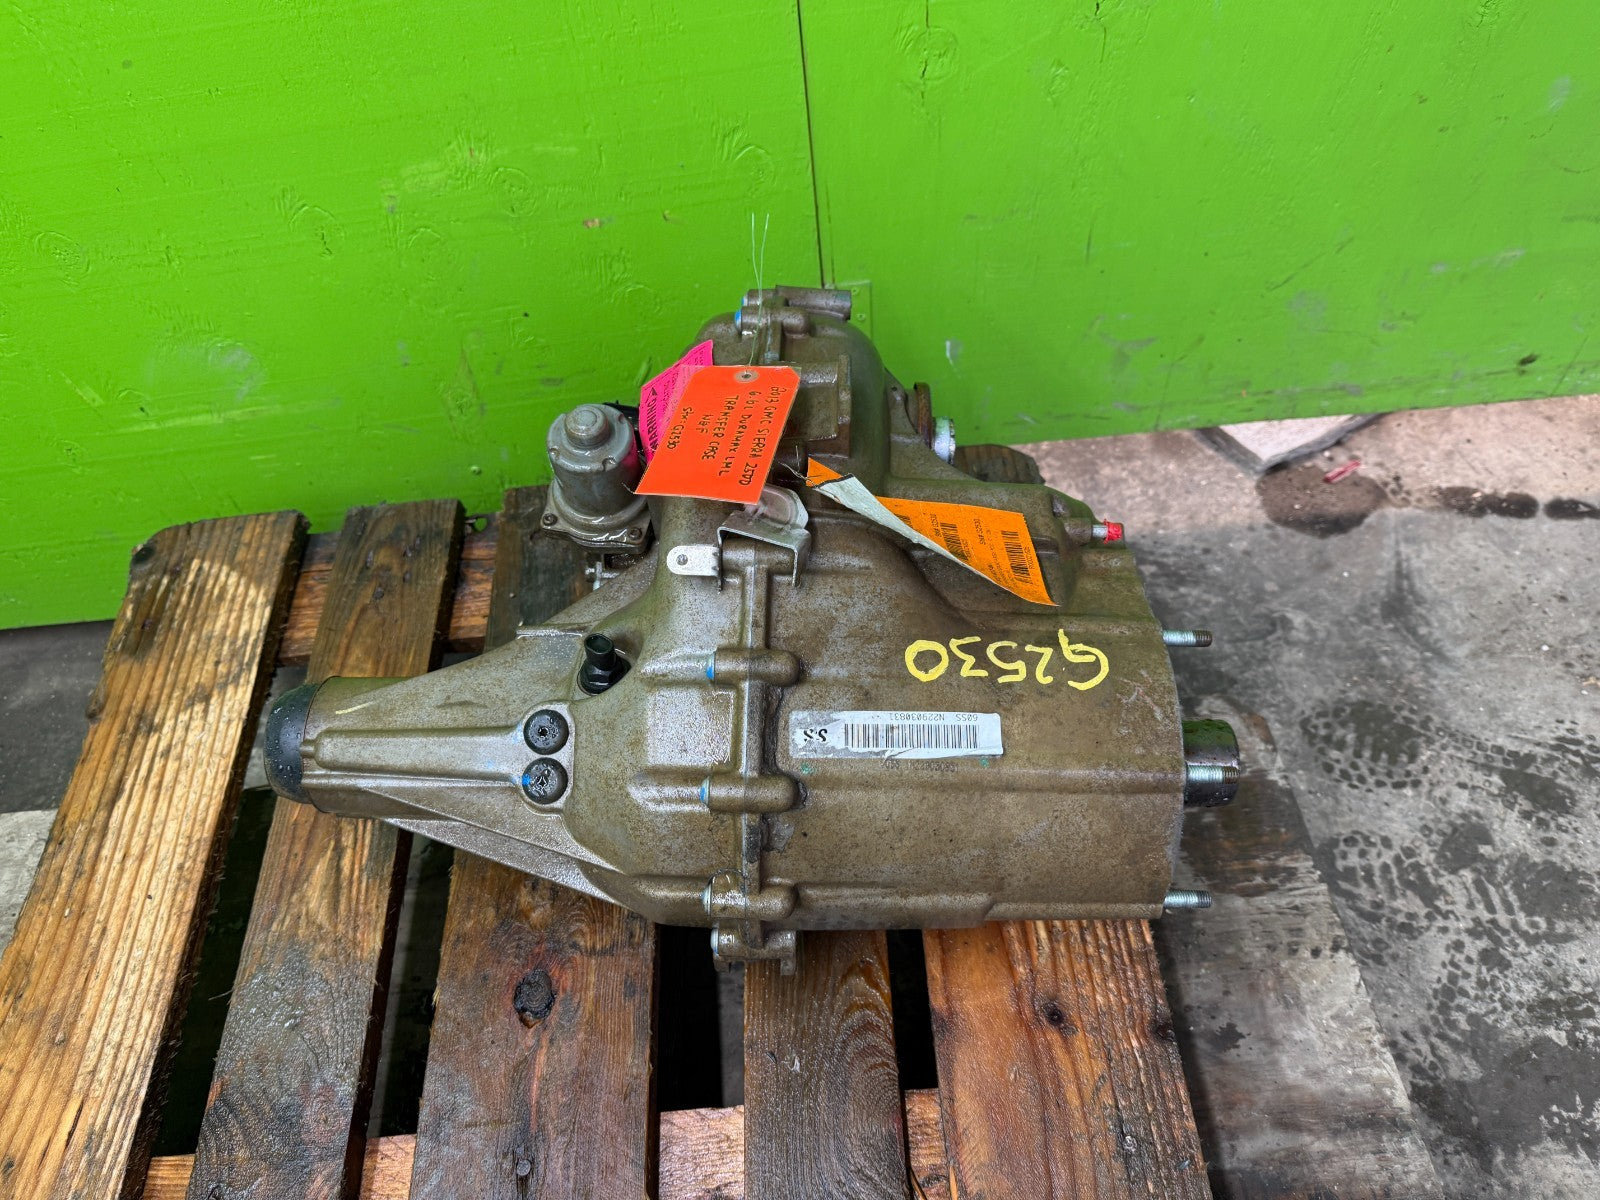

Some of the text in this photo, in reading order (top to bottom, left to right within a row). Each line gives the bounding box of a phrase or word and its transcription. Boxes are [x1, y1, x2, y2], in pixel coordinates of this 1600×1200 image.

[667, 425, 685, 450] G2530
[702, 395, 739, 461] TRANSFER CASE
[738, 386, 787, 486] 2013 GMC SIERRA 2500
[719, 456, 736, 477] LML
[905, 628, 1110, 690] G2530
